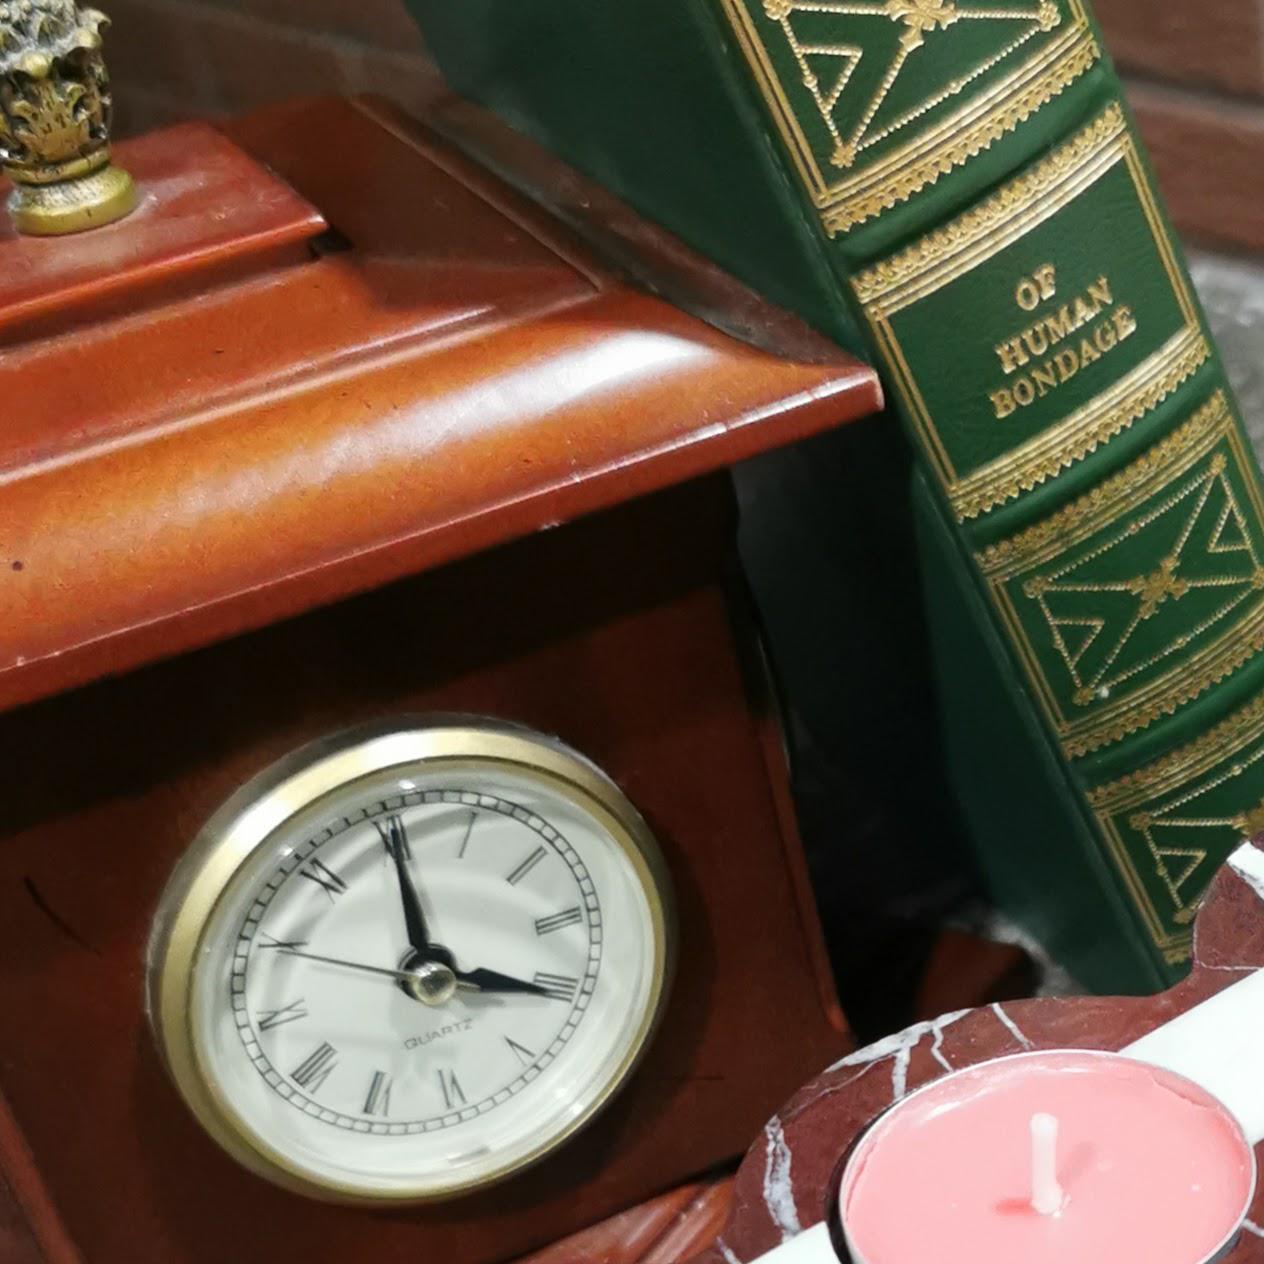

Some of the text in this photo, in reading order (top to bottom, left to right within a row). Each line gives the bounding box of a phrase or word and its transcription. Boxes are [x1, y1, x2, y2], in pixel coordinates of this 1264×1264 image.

[1015, 263, 1056, 311] OF
[994, 275, 1113, 375] HUMAN
[989, 306, 1137, 419] BONDAGE
[300, 857, 348, 904] XI
[535, 906, 583, 936] III
[256, 999, 308, 1031] IX
[404, 1018, 473, 1050] QUARTZ
